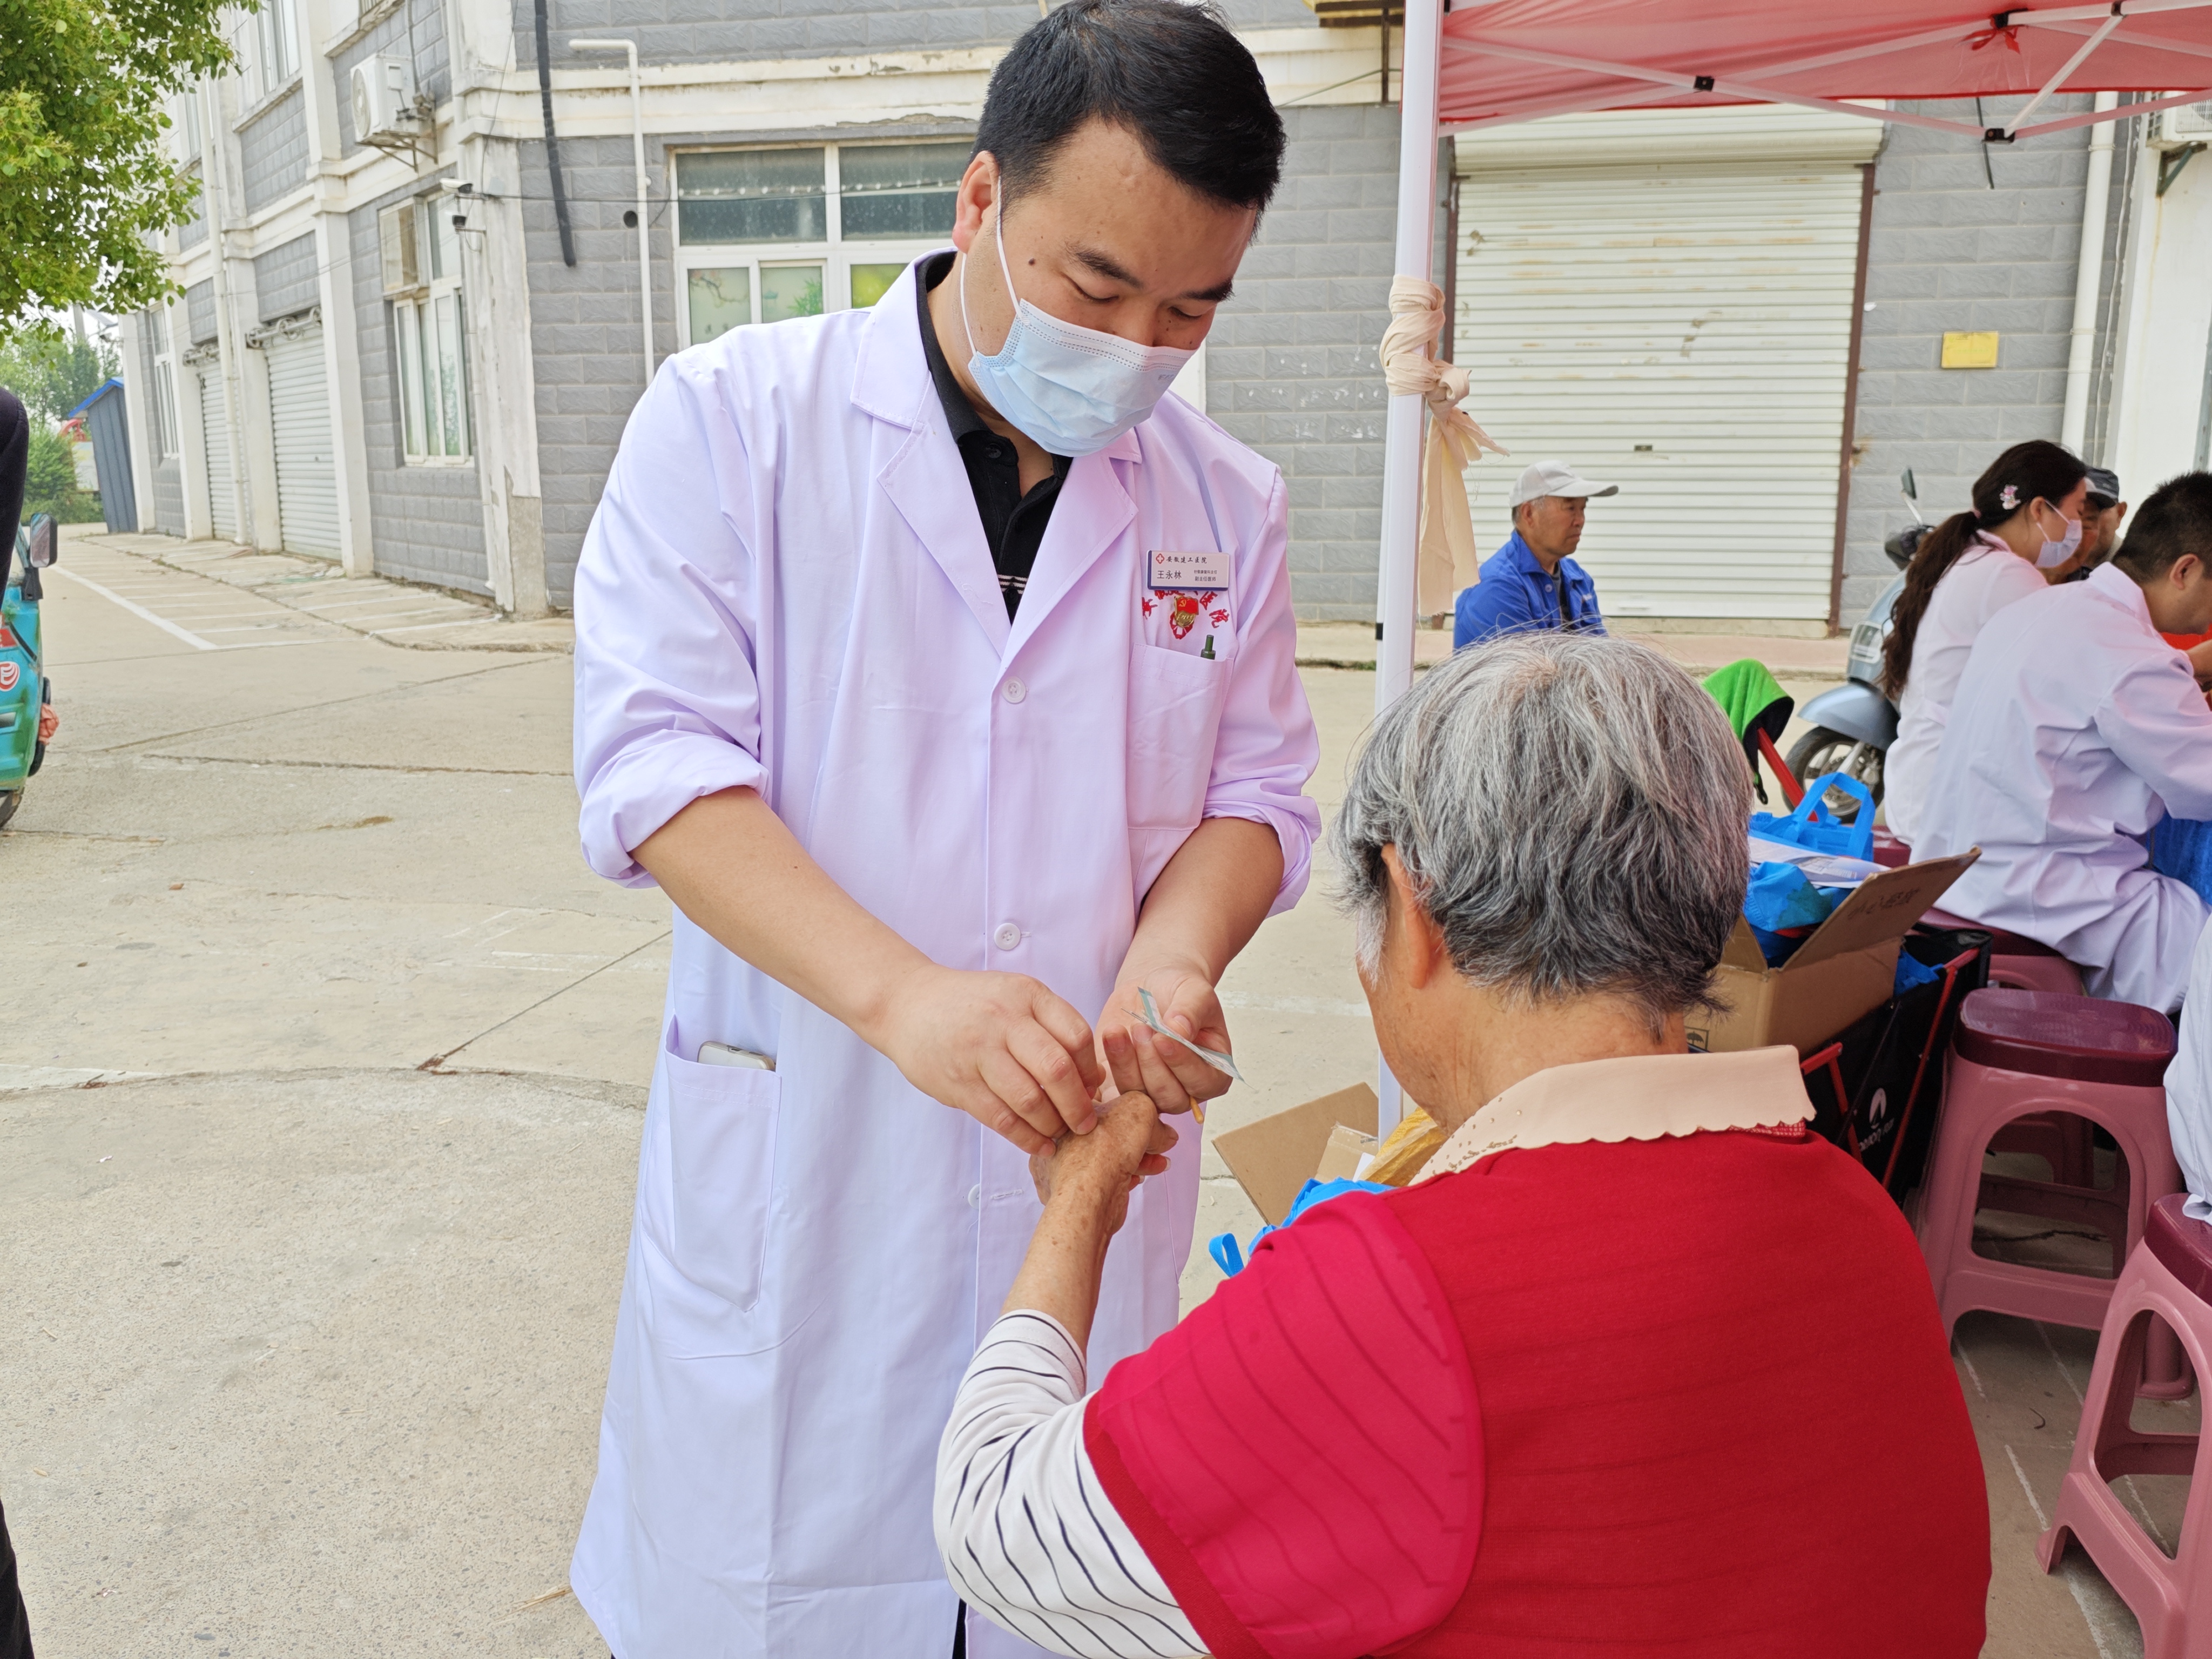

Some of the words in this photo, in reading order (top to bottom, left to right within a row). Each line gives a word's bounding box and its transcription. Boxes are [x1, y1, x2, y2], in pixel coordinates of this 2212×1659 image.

[1166, 556, 1208, 564] 安徽建工医院
[1157, 570, 1182, 579] 王永林
